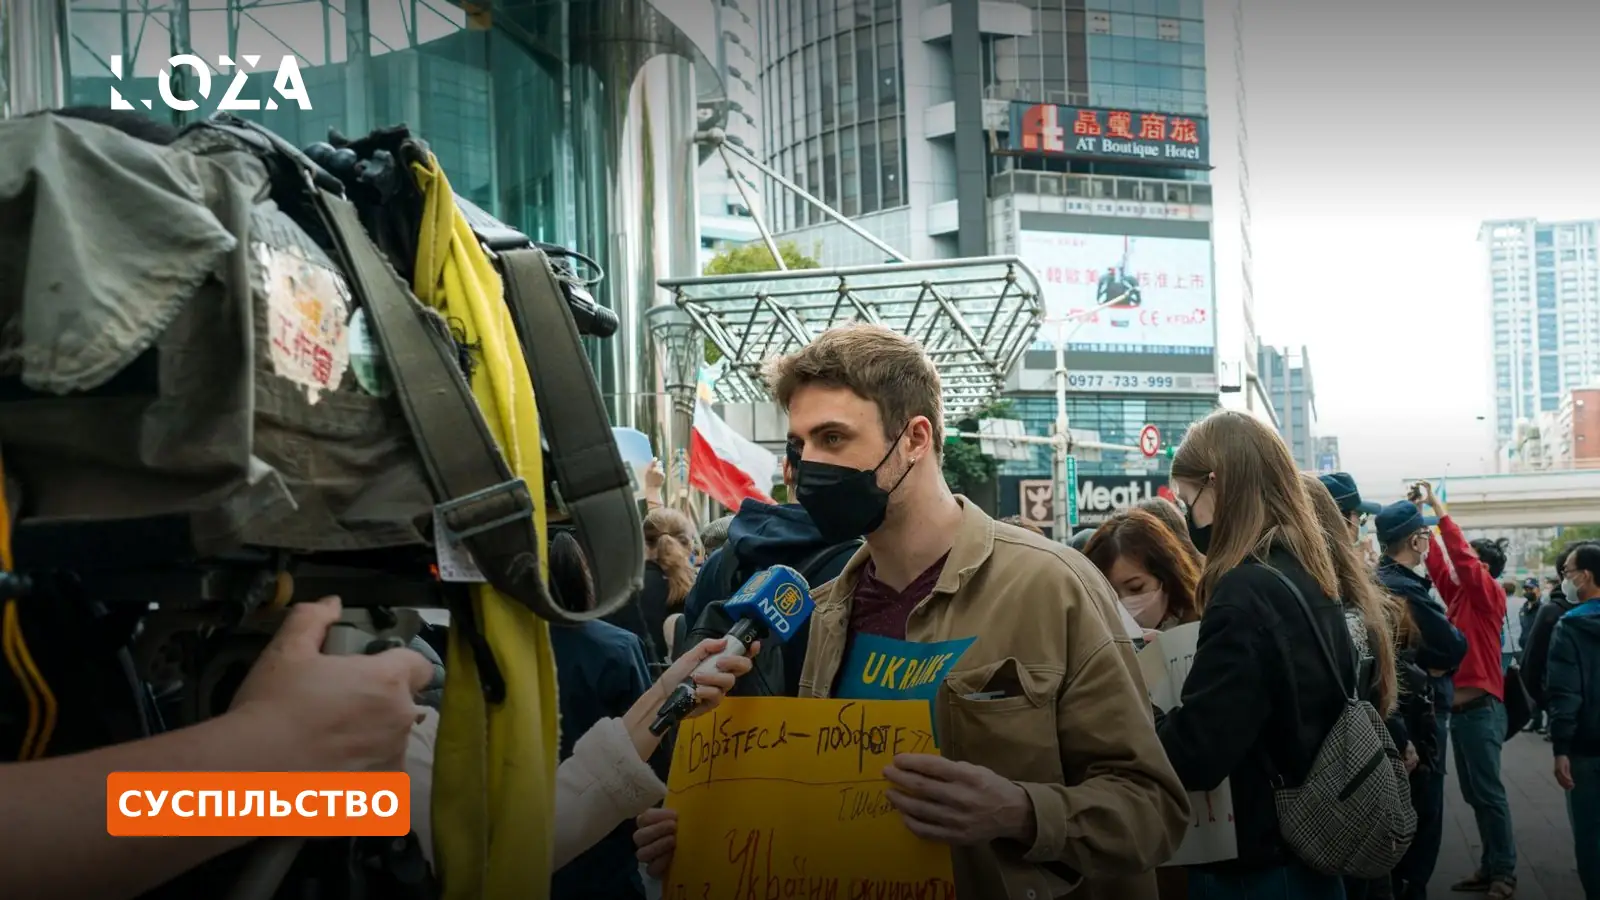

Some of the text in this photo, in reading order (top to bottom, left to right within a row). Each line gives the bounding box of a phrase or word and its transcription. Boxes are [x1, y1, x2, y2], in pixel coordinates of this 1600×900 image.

[1076, 137, 1200, 160] AT Boutique Hotel
[1078, 480, 1141, 511] Meat
[757, 597, 790, 633] NTD
[862, 651, 954, 690] UKRAINE
